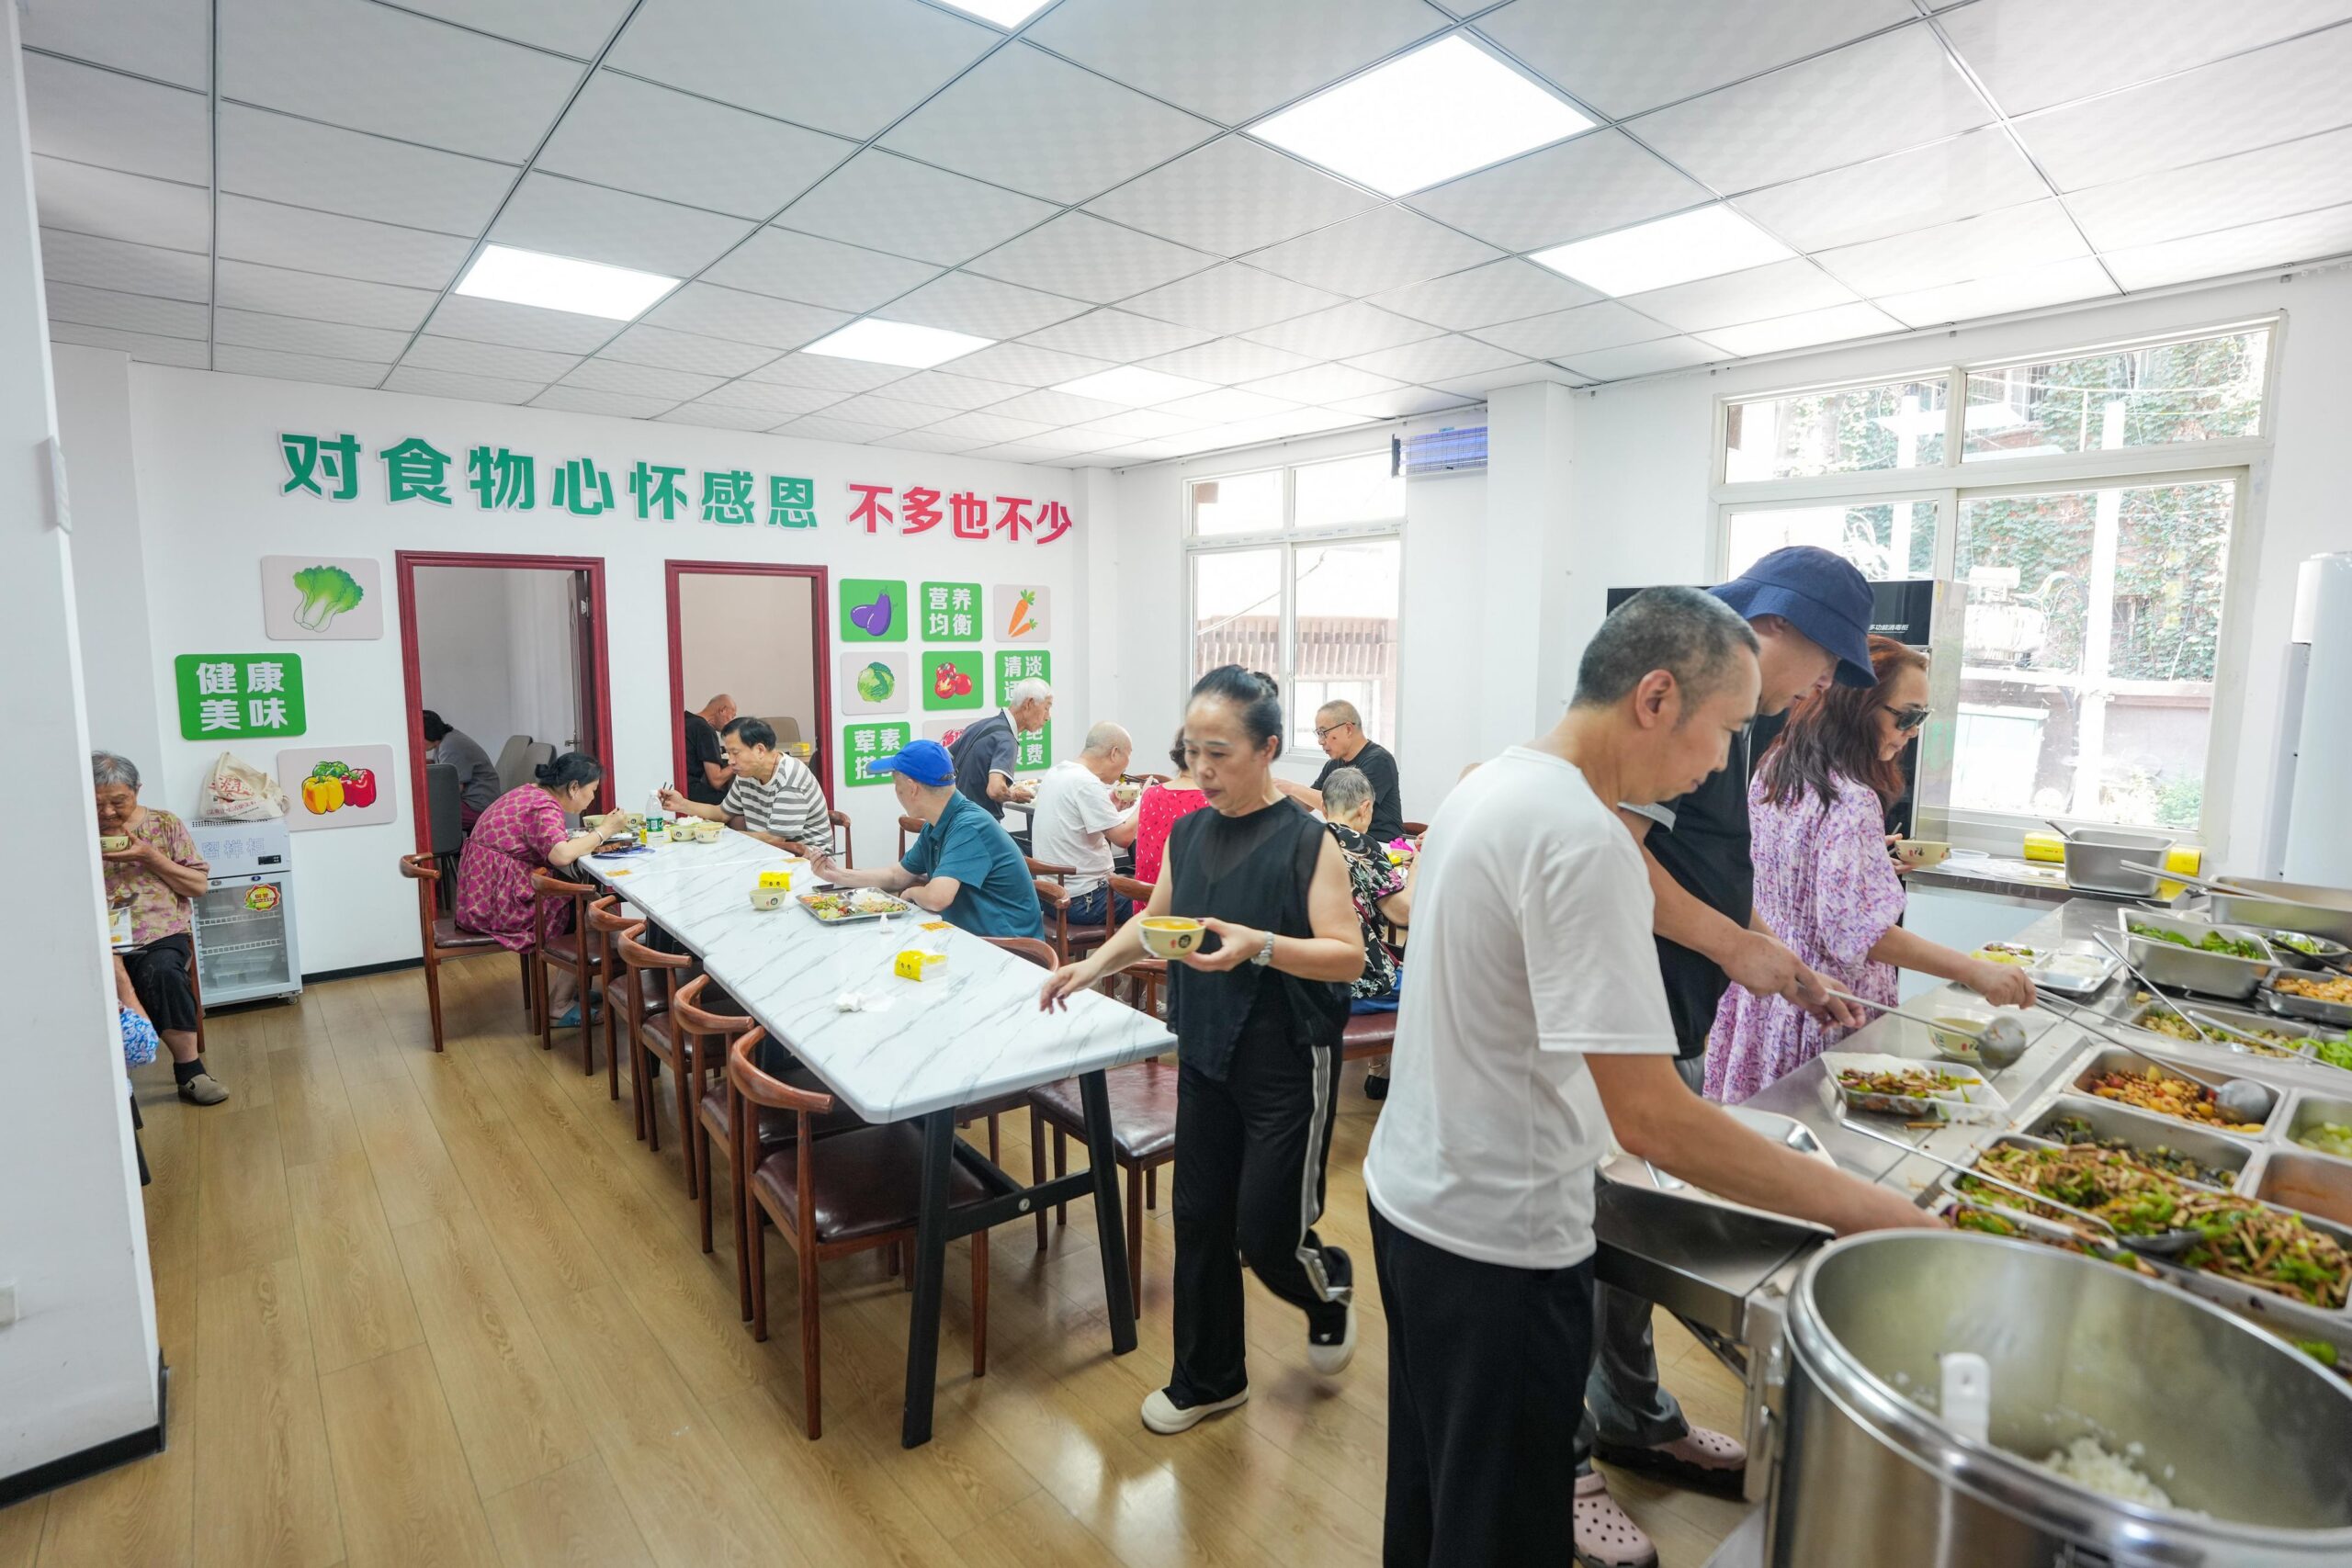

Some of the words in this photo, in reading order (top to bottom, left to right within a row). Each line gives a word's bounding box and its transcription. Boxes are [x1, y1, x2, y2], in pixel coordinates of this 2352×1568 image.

[282, 434, 819, 529] 对食物心怀感恩
[849, 483, 1073, 545] 不多也不少
[928, 587, 972, 611] 营养
[928, 613, 972, 637] 均衡
[196, 661, 284, 695] 健康
[1003, 655, 1043, 679] 清淡
[200, 697, 288, 731] 美味
[854, 728, 901, 753] 荤素
[201, 837, 266, 860] 留样柜
